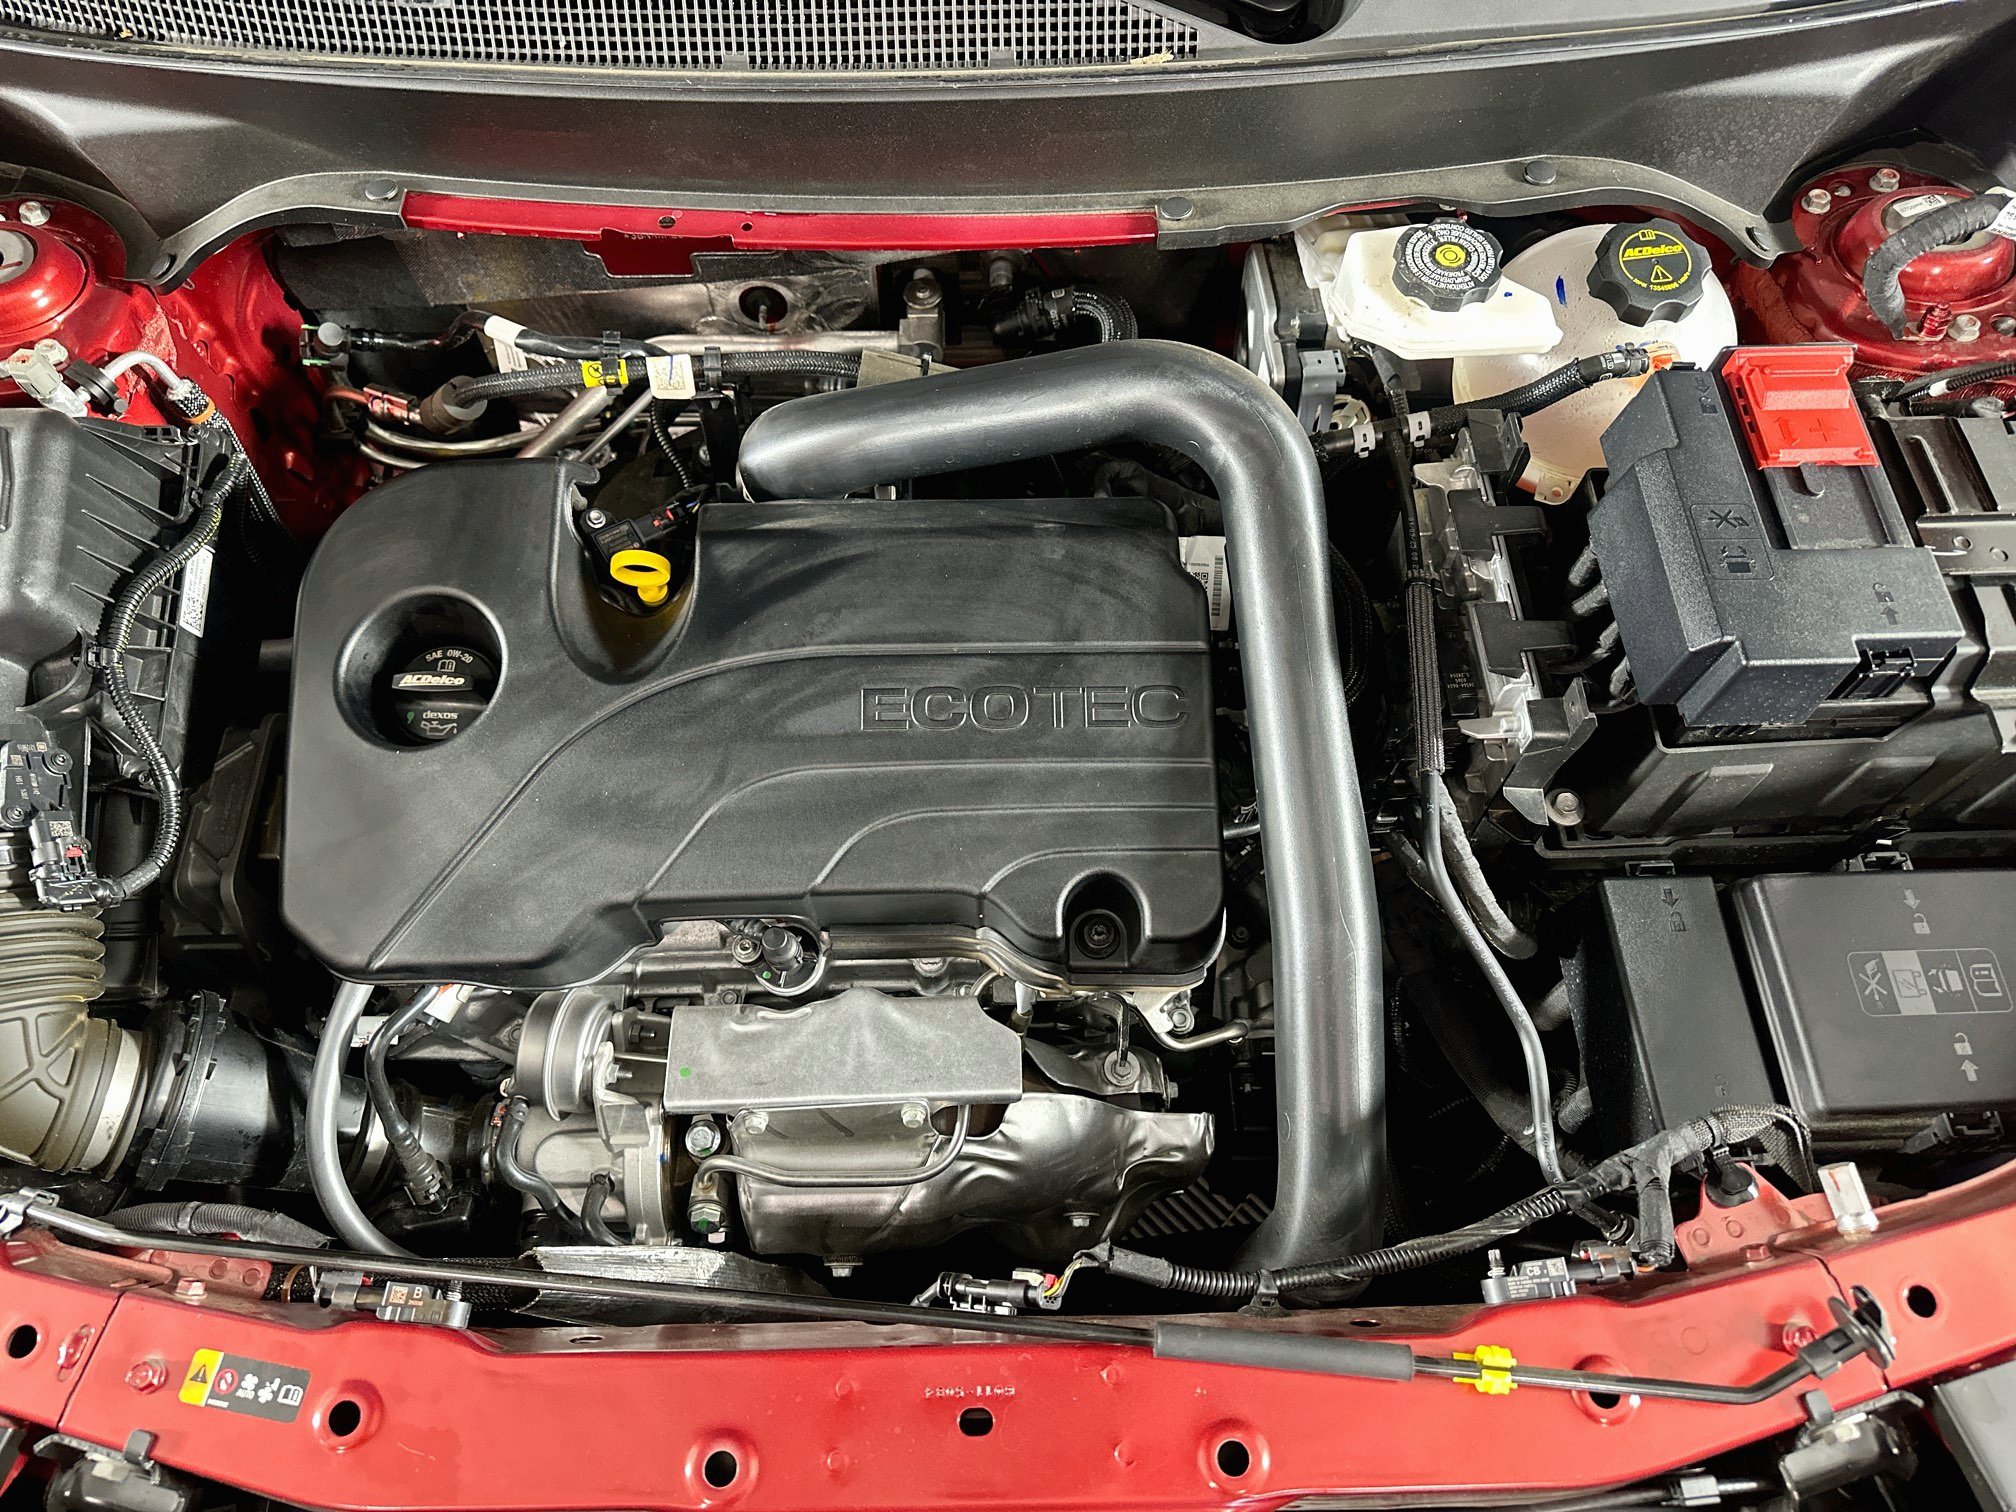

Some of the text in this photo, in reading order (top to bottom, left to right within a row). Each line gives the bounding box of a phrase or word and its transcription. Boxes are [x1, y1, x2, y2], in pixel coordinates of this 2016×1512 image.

[1622, 245, 1683, 260] ACDelco
[425, 649, 474, 663] SAE 0W-20
[399, 675, 465, 686] ACDelco
[861, 684, 1188, 731] ECOTEC
[423, 711, 458, 719] dexos
[1526, 1266, 1541, 1276] CB
[413, 1286, 423, 1299] B
[236, 1388, 255, 1400] AUTO
